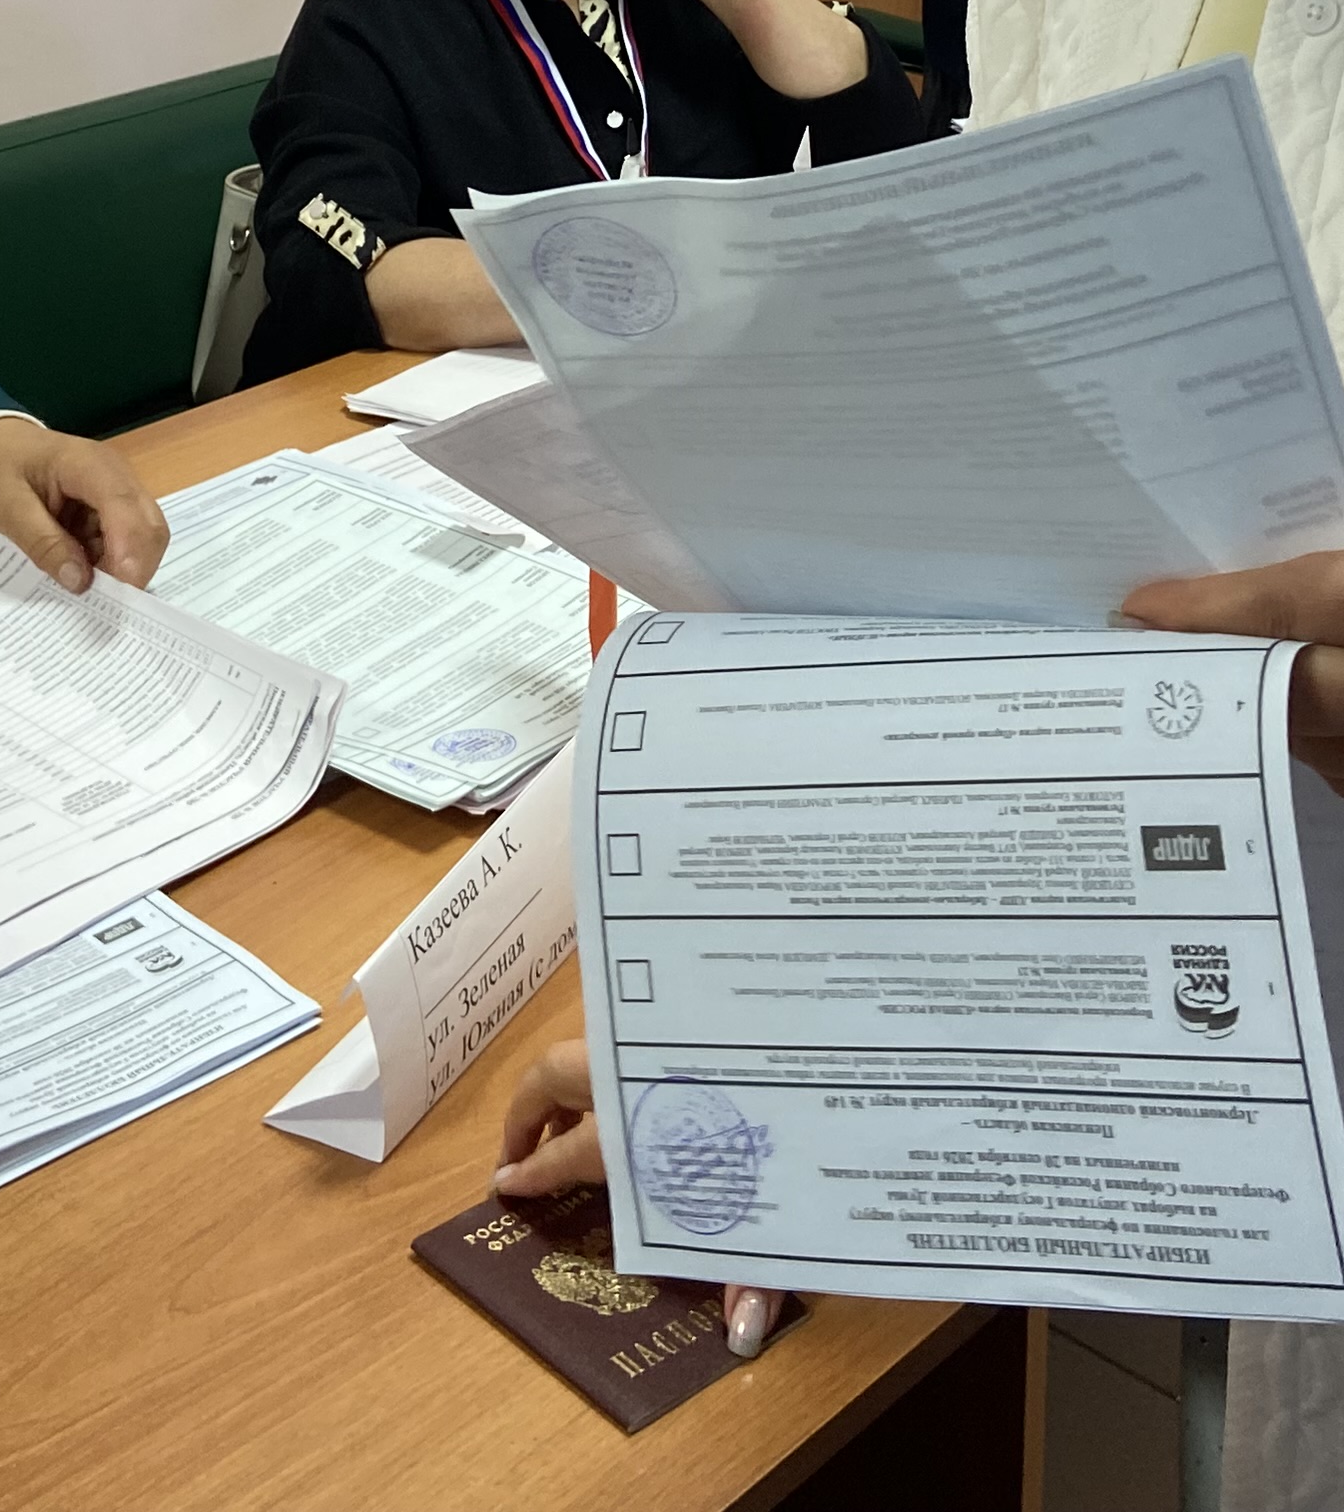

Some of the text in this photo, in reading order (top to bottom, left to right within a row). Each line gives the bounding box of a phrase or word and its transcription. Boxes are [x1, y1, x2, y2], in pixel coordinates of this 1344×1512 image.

[1152, 834, 1211, 862] ЛДПР
[407, 826, 523, 964] Казеева А. К.
[1170, 944, 1227, 956] РОССИЯ
[1173, 958, 1230, 969] ЕДИНАЯ
[425, 933, 526, 1061] ул. Зеленая
[428, 1067, 455, 1105] ул.
[460, 975, 525, 1061] Южная
[1138, 1105, 1259, 1125] Лермонтовский
[1104, 1178, 1177, 1197] Собрания
[1180, 1183, 1290, 1204] Федерального
[1143, 1224, 1238, 1240] голосования
[1241, 1229, 1270, 1241] для
[906, 1233, 1211, 1265] ИЗБИРАТЕЛЬНЫЙ БЮЛЛЕТЕНЬ
